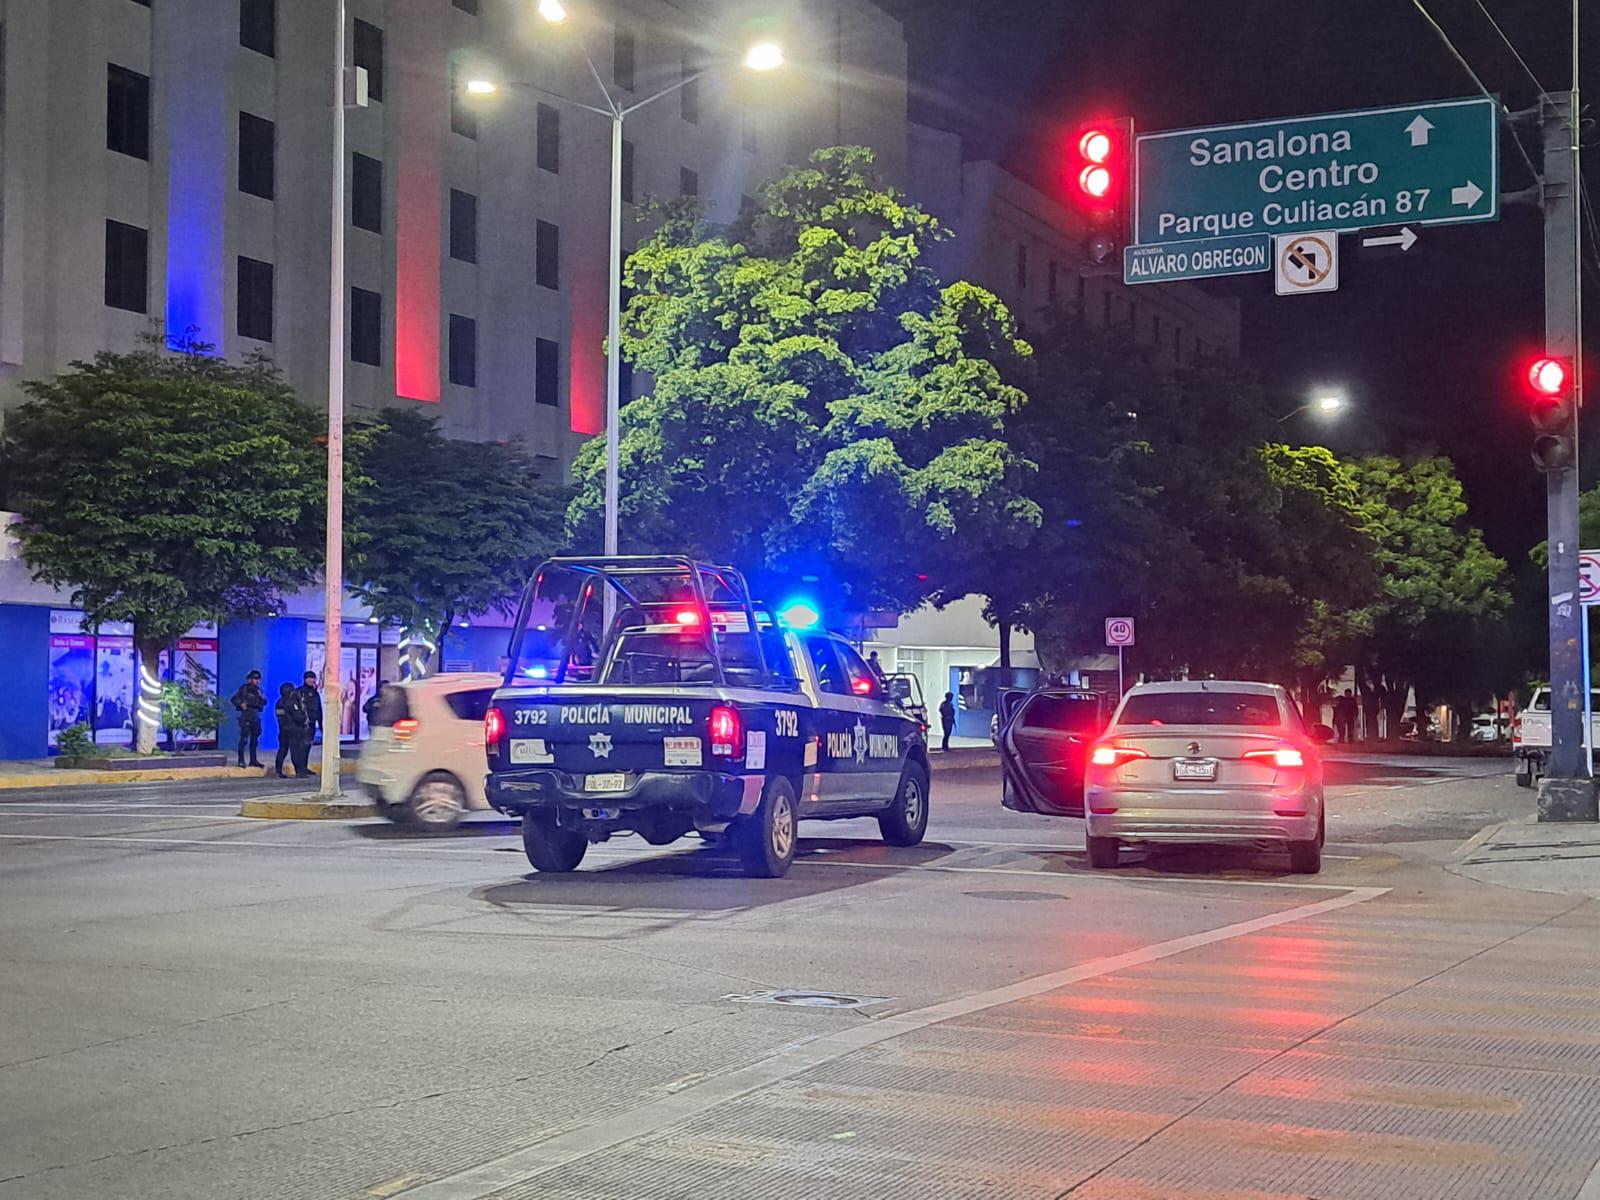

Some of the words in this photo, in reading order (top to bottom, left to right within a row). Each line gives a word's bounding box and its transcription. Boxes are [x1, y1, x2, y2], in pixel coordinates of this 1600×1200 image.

[1190, 129, 1352, 167] Sanalona
[1258, 160, 1379, 194] Centro
[1158, 208, 1255, 237] Parque
[1263, 193, 1387, 225] Culiacán
[1395, 189, 1431, 213] 87
[1131, 253, 1188, 277] ALVARO
[1192, 245, 1265, 271] OBREGON
[1113, 624, 1126, 634] 40
[514, 709, 548, 725] 3792
[560, 703, 610, 725] POLICÍA
[624, 706, 693, 725] MUNICIPAL
[775, 709, 799, 738] 3792
[826, 728, 853, 759] POLICÍA
[868, 732, 899, 759] MUNICIPAL
